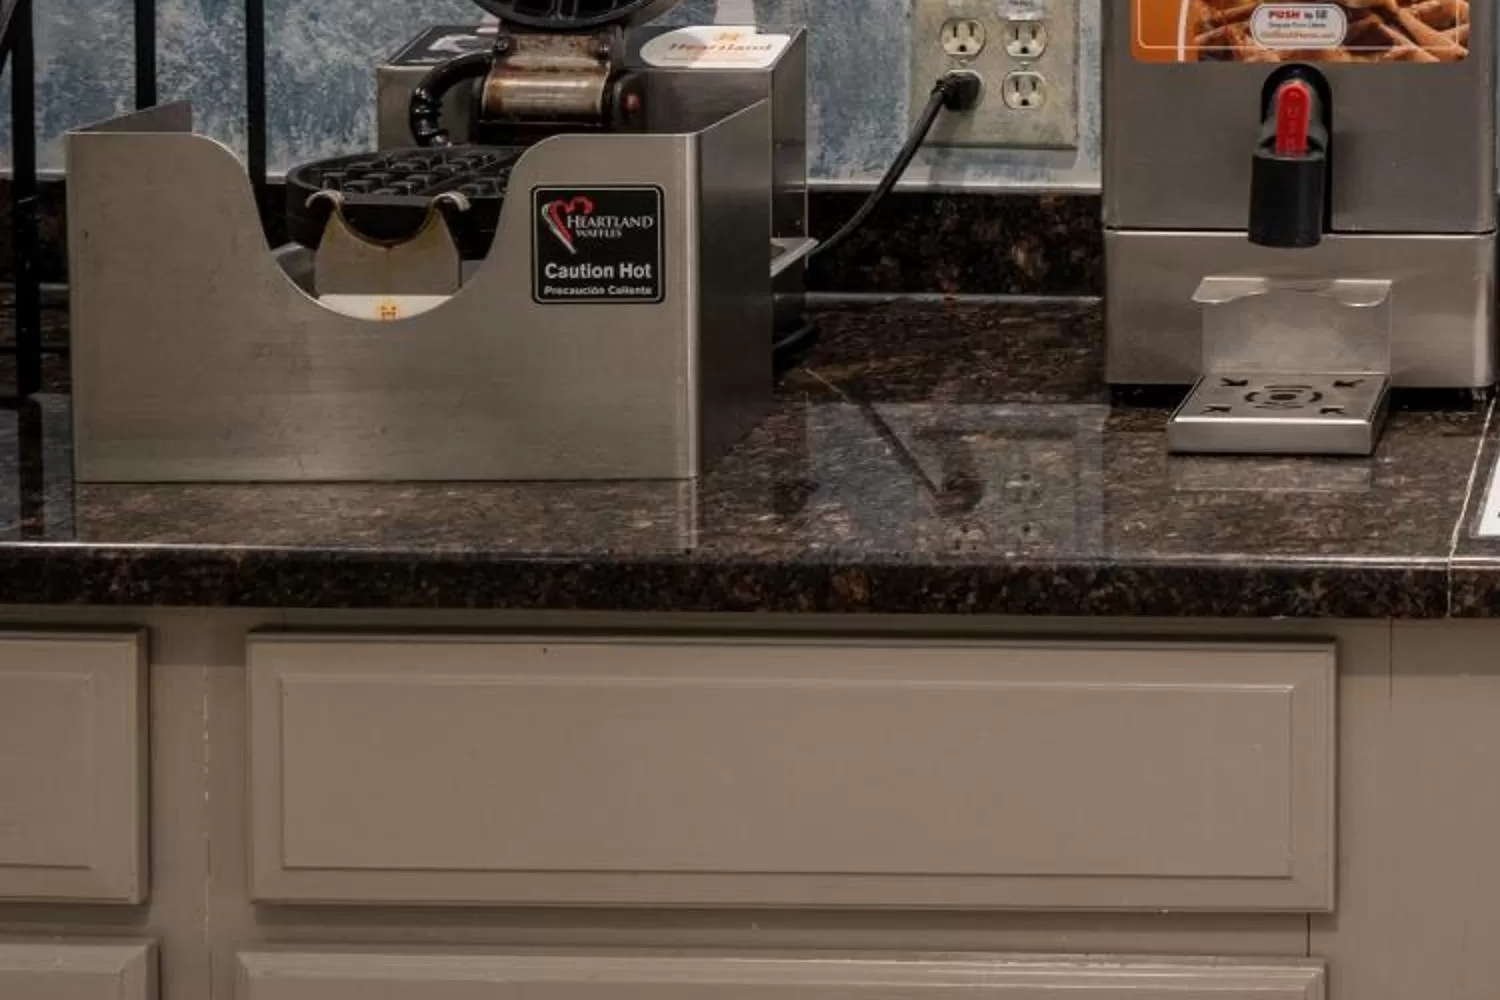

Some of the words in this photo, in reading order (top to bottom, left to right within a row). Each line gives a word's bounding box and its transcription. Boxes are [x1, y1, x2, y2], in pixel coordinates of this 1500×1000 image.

[567, 215, 654, 229] HEARTLAND
[575, 229, 622, 238] WAFFLES
[544, 262, 614, 279] Caution
[619, 262, 653, 279] Hot
